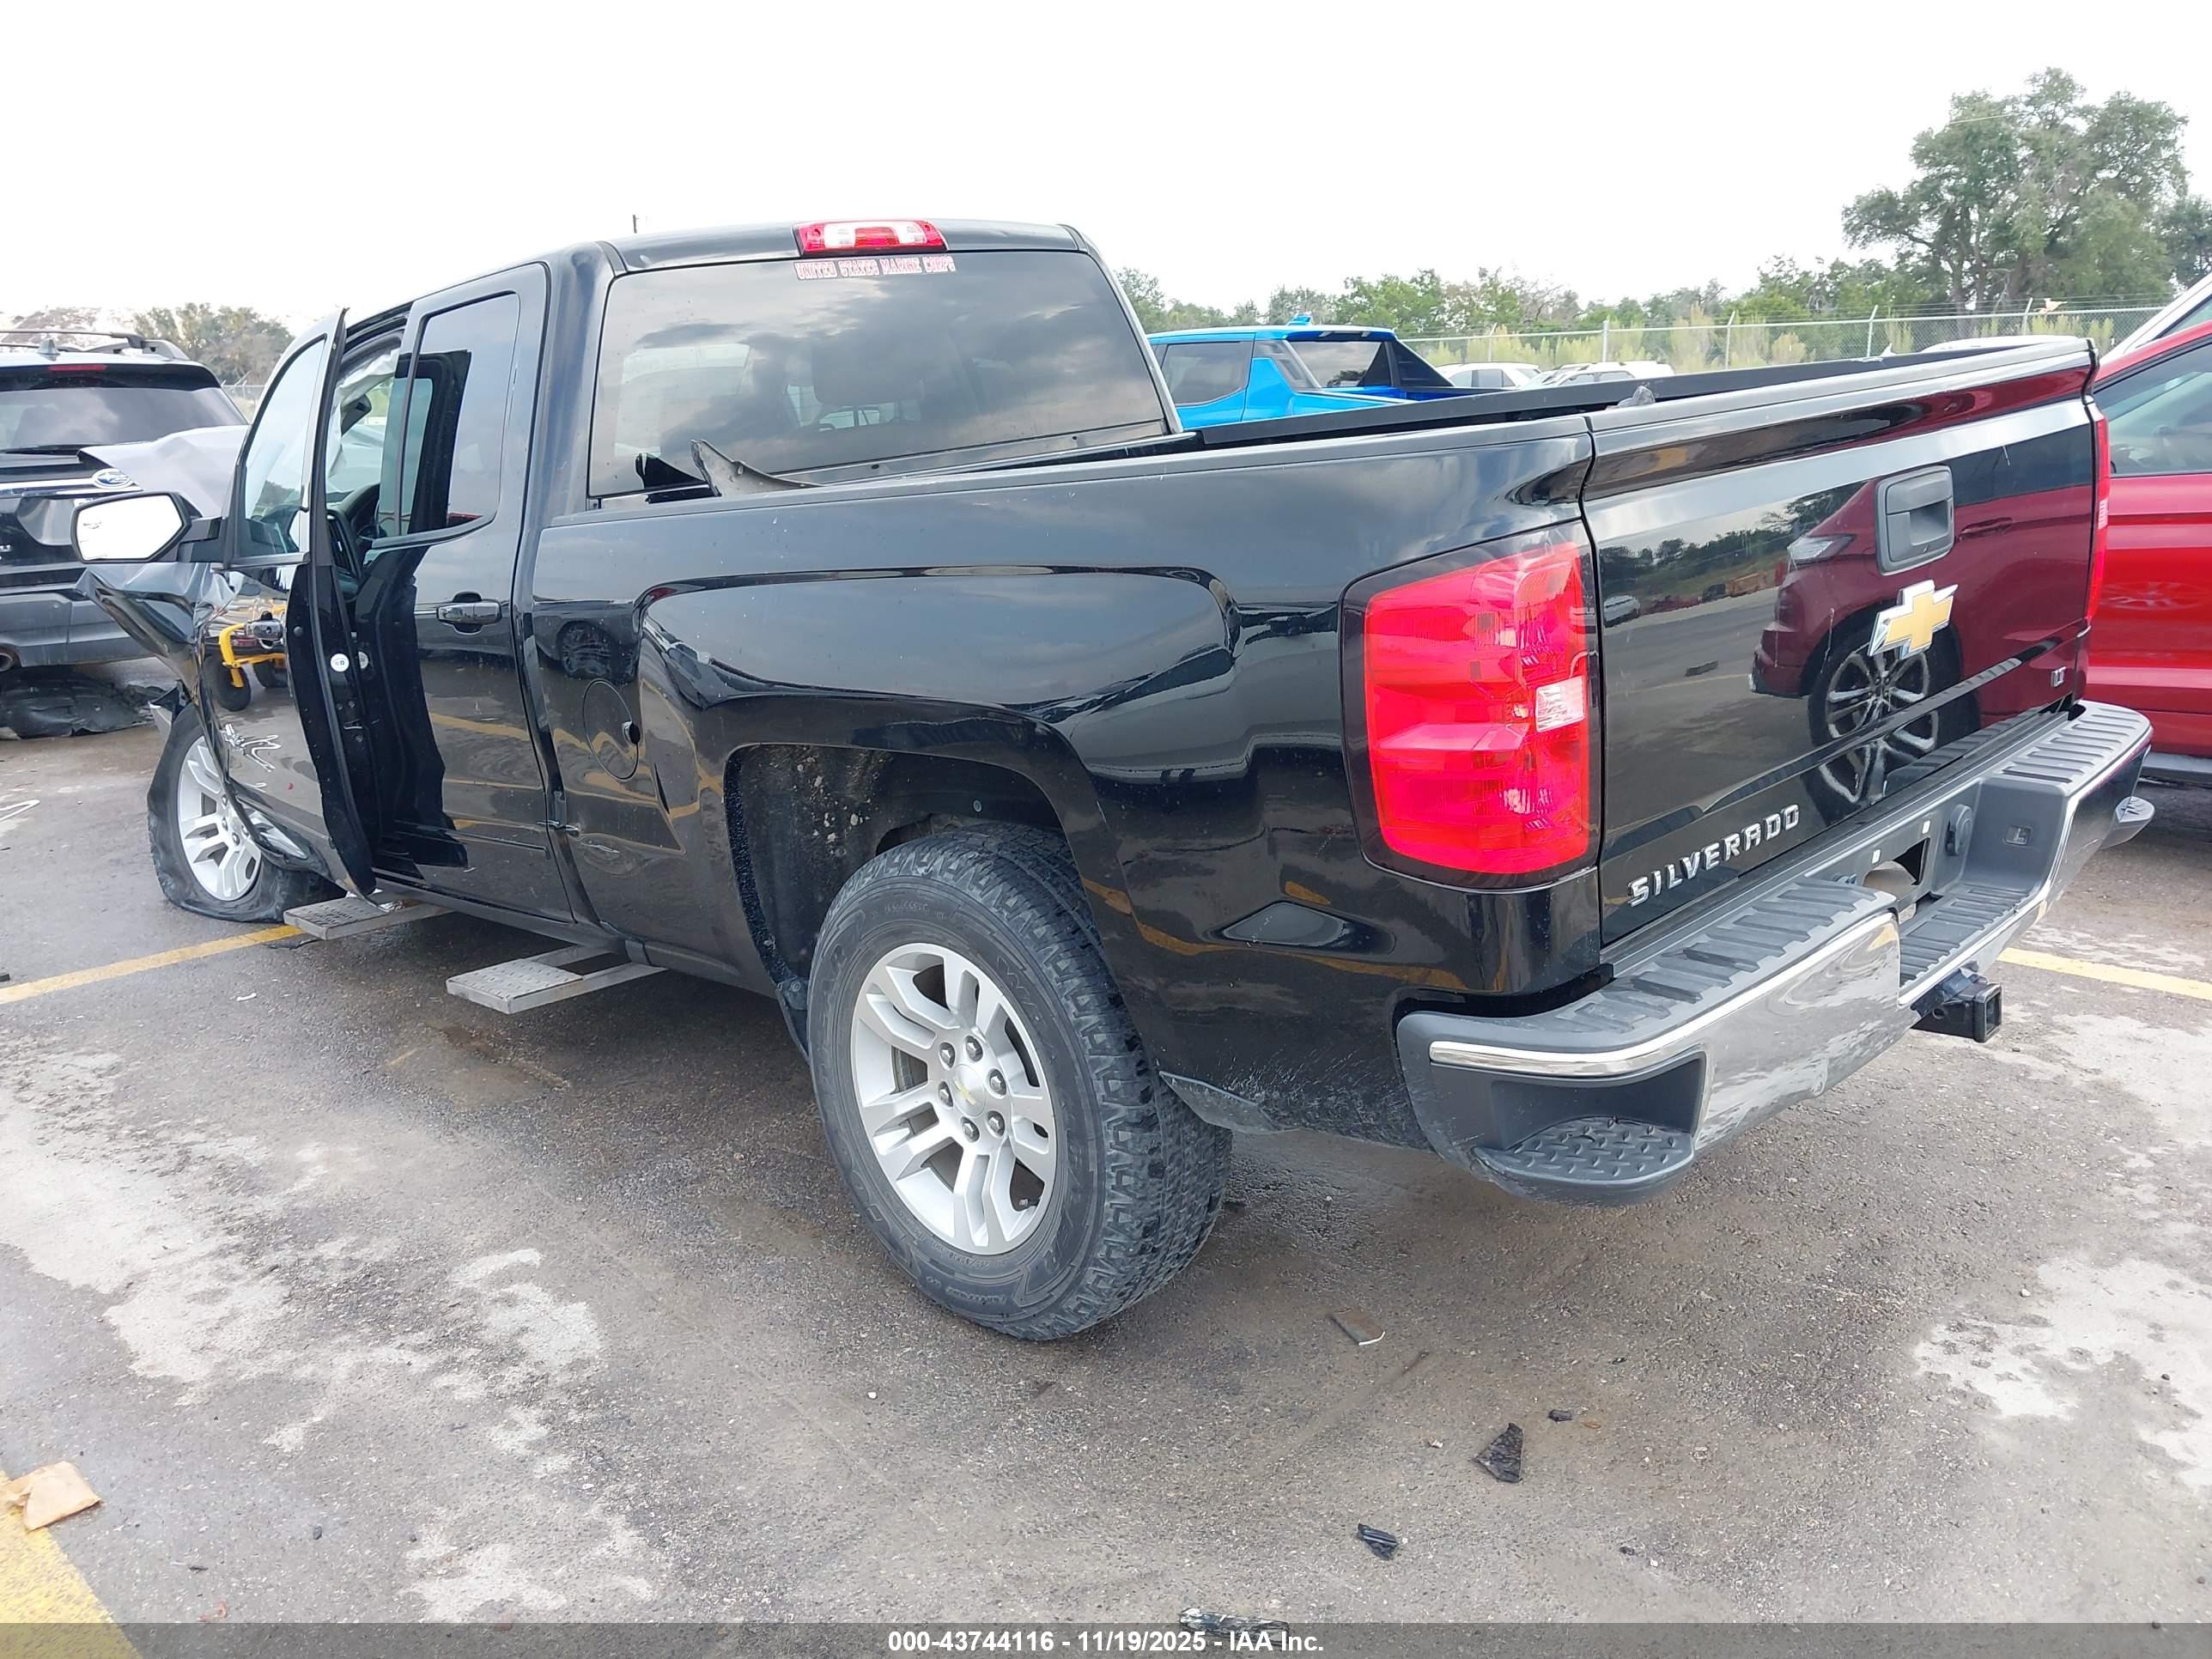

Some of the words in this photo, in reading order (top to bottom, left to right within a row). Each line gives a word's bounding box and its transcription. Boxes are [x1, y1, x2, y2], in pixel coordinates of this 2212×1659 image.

[794, 261, 837, 280] UNITED
[838, 258, 879, 277] STATES
[879, 257, 923, 275] MARINE
[922, 255, 957, 273] CORPS
[1627, 804, 1800, 908] SILVERADO
